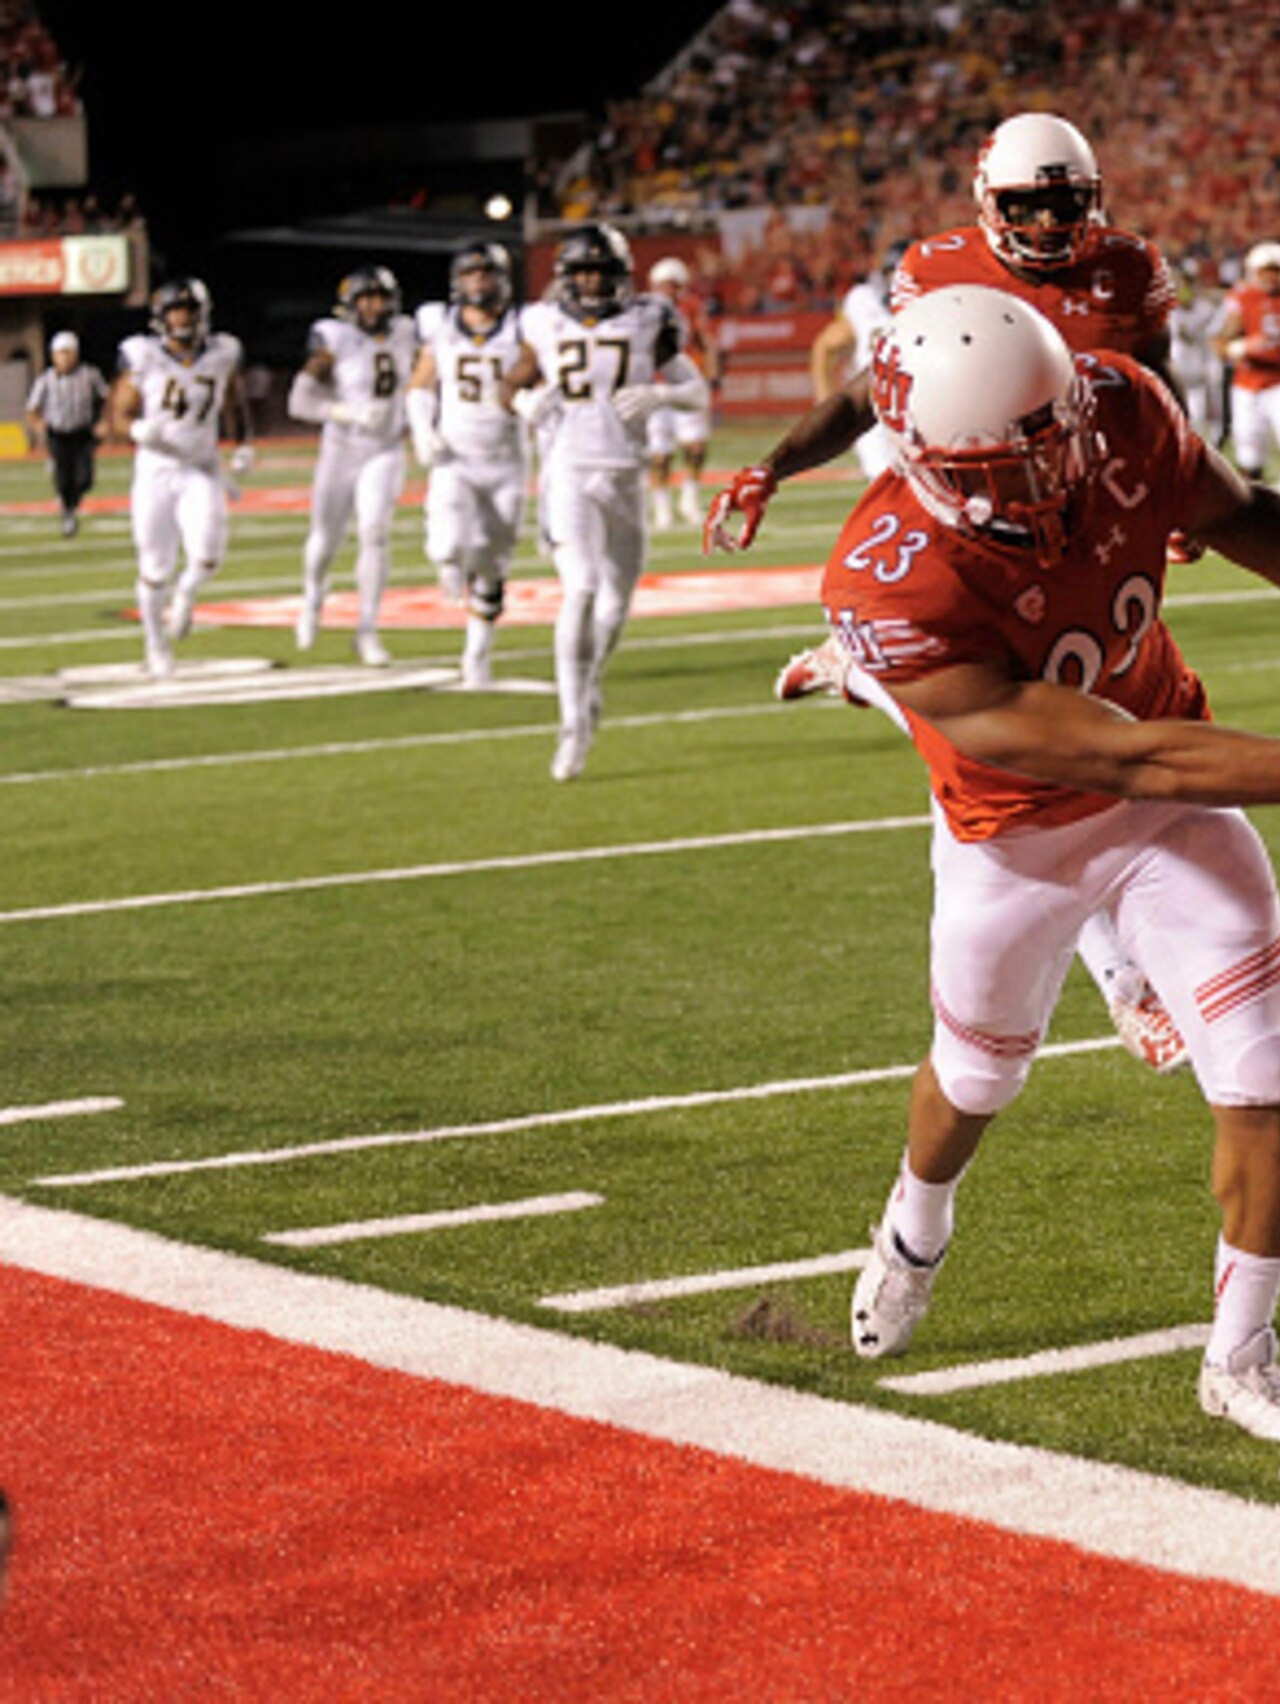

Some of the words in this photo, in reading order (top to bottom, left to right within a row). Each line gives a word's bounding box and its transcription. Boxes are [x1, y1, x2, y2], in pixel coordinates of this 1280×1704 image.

[374, 352, 396, 398] 8
[456, 355, 503, 402] 51
[558, 338, 630, 400] 27
[161, 374, 215, 422] 47
[1101, 456, 1147, 508] C
[842, 512, 930, 584] 23
